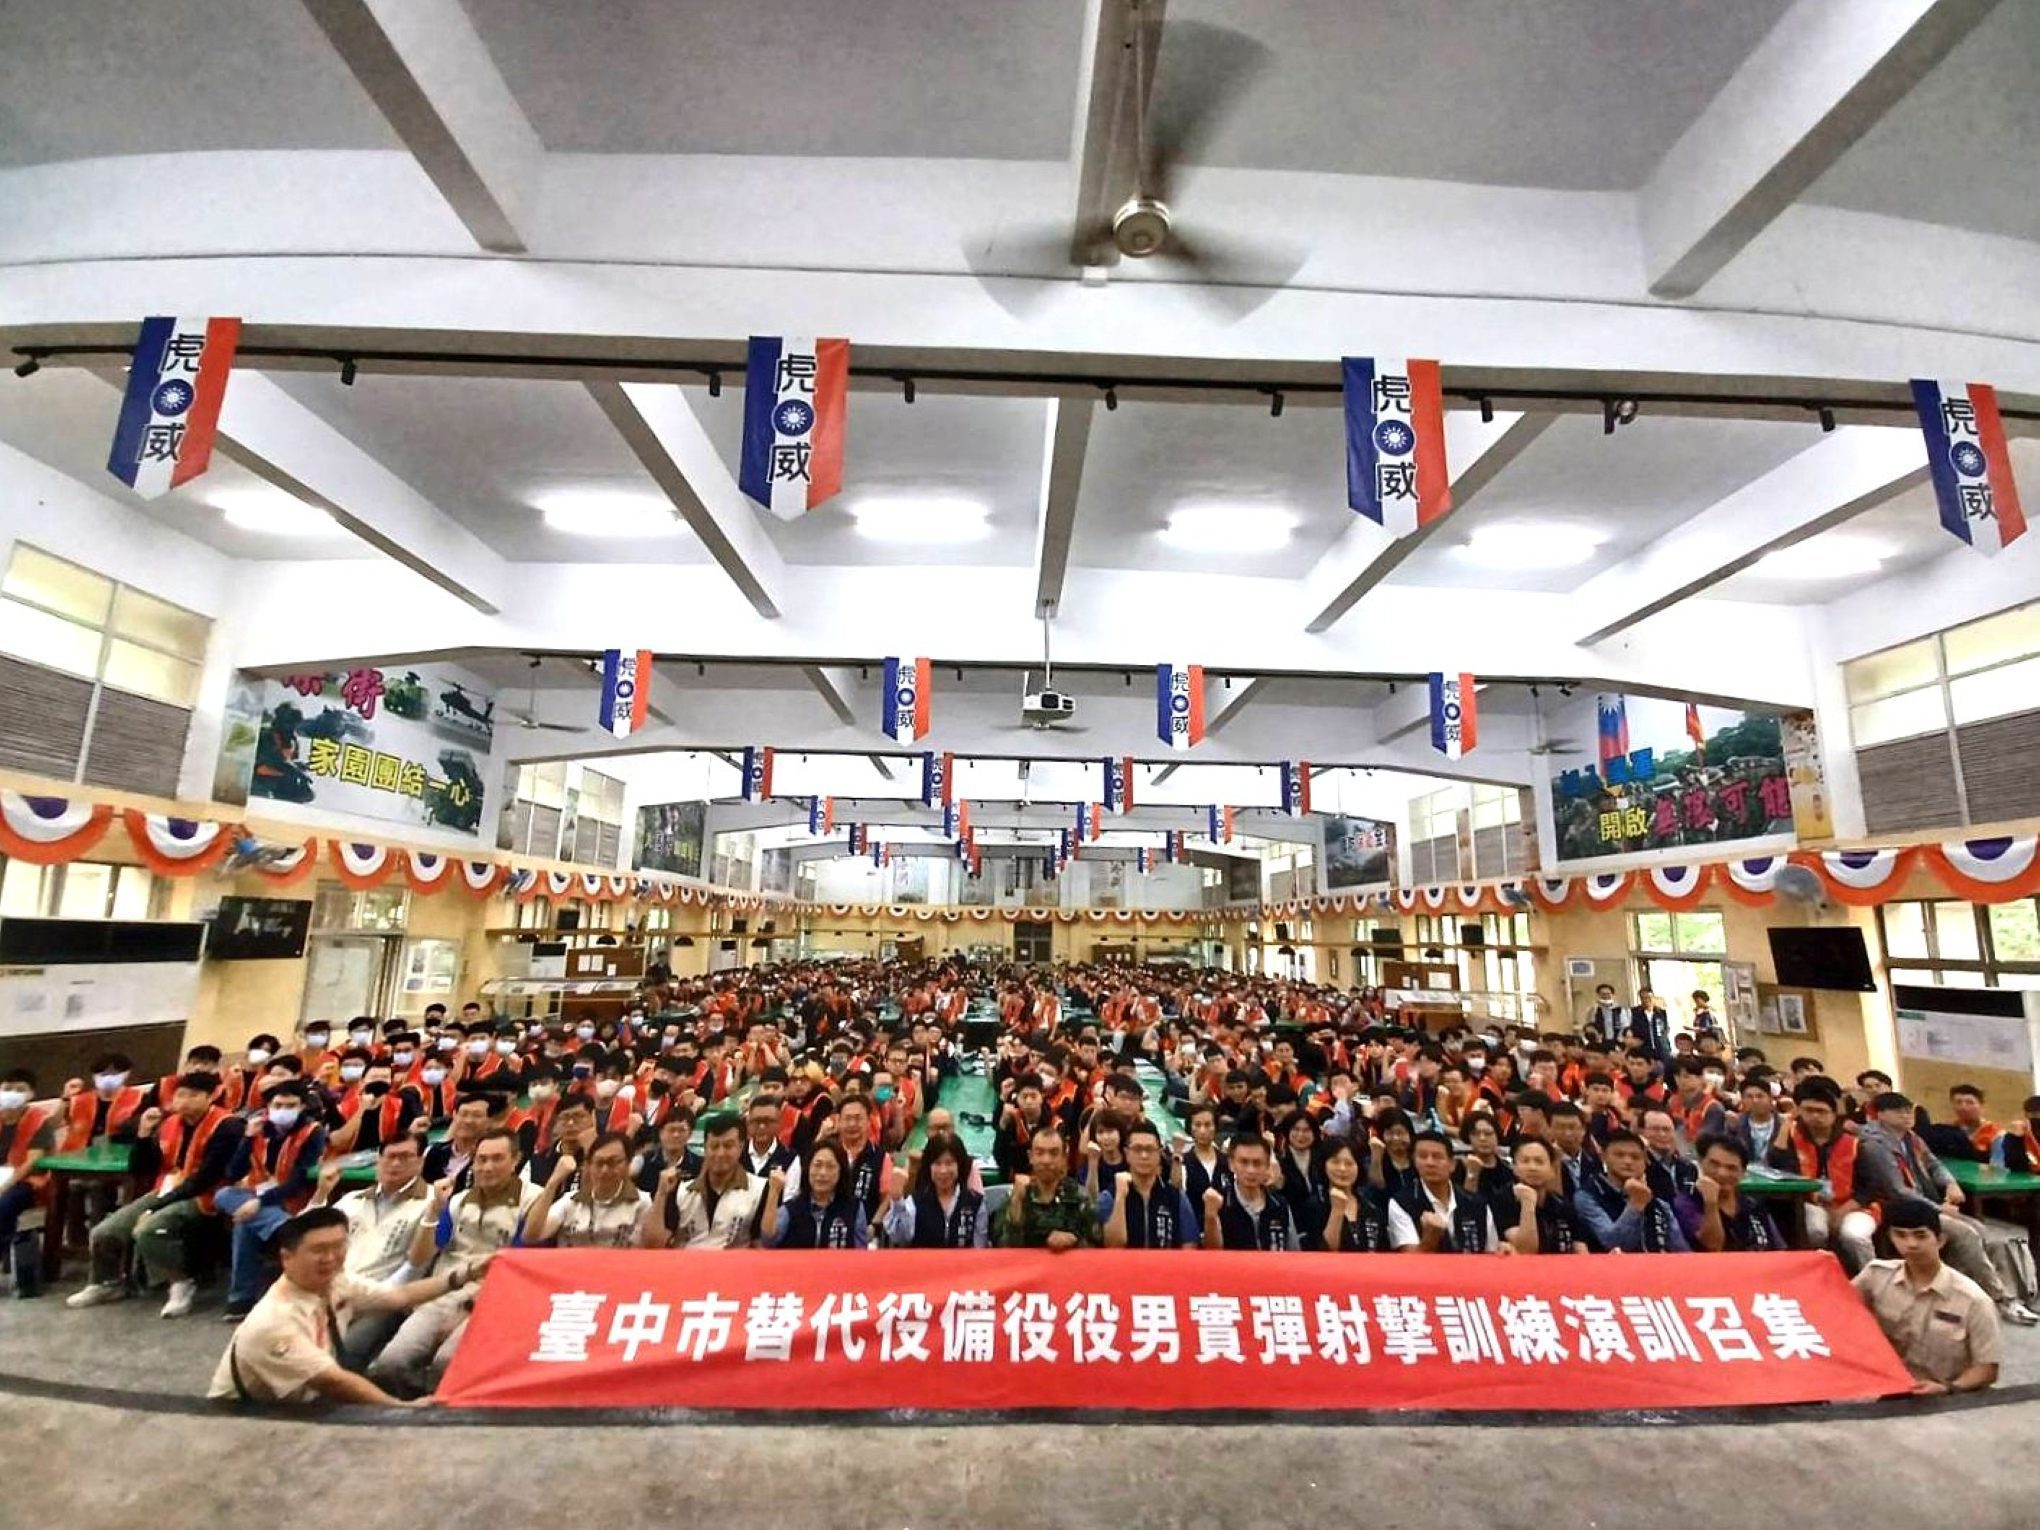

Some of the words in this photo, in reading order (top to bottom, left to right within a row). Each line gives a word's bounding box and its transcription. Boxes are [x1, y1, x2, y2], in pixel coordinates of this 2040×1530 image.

[137, 333, 205, 463] 虎威
[766, 353, 817, 485] 虎威
[1371, 373, 1420, 503] 虎威
[1942, 396, 1999, 522] 虎威
[309, 738, 471, 807] 家園團結一心
[529, 1290, 1831, 1366] 臺中市替代役備役役男實彈射擊訓練演訓召集
